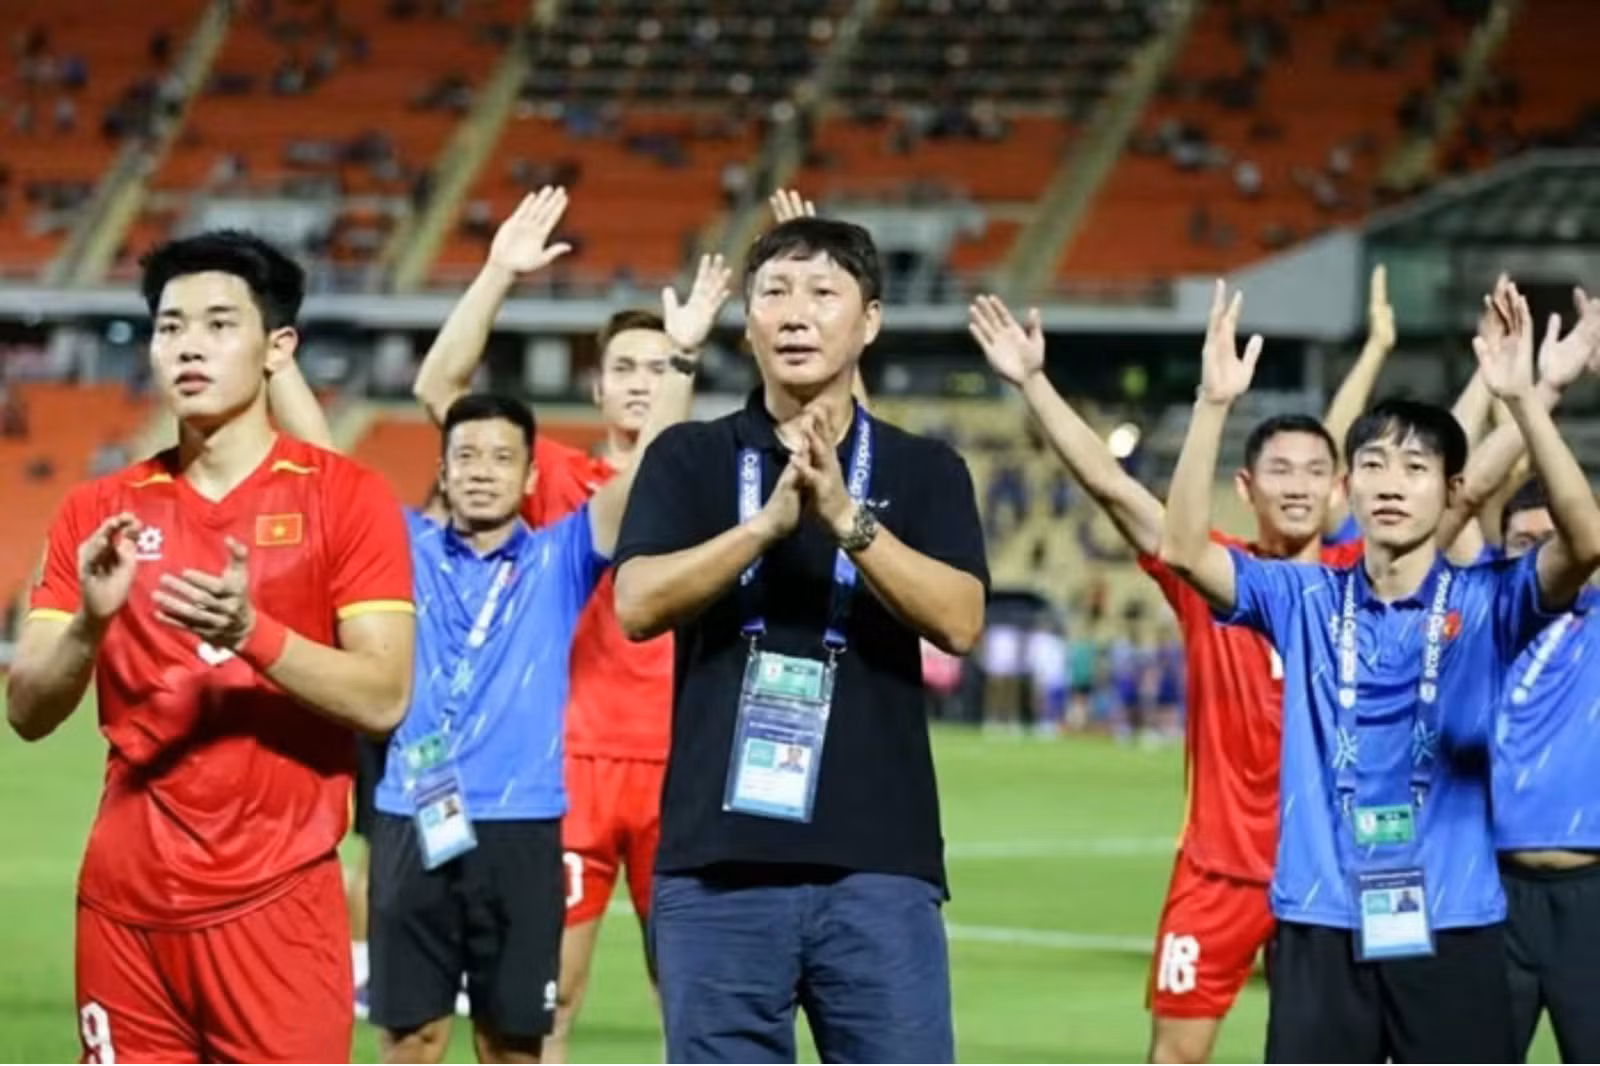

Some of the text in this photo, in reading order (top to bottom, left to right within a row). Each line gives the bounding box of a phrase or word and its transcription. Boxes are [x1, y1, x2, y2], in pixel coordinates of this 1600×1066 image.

[741, 453, 759, 480] Cup
[1157, 931, 1200, 995] 18
[80, 1001, 115, 1065] 9
